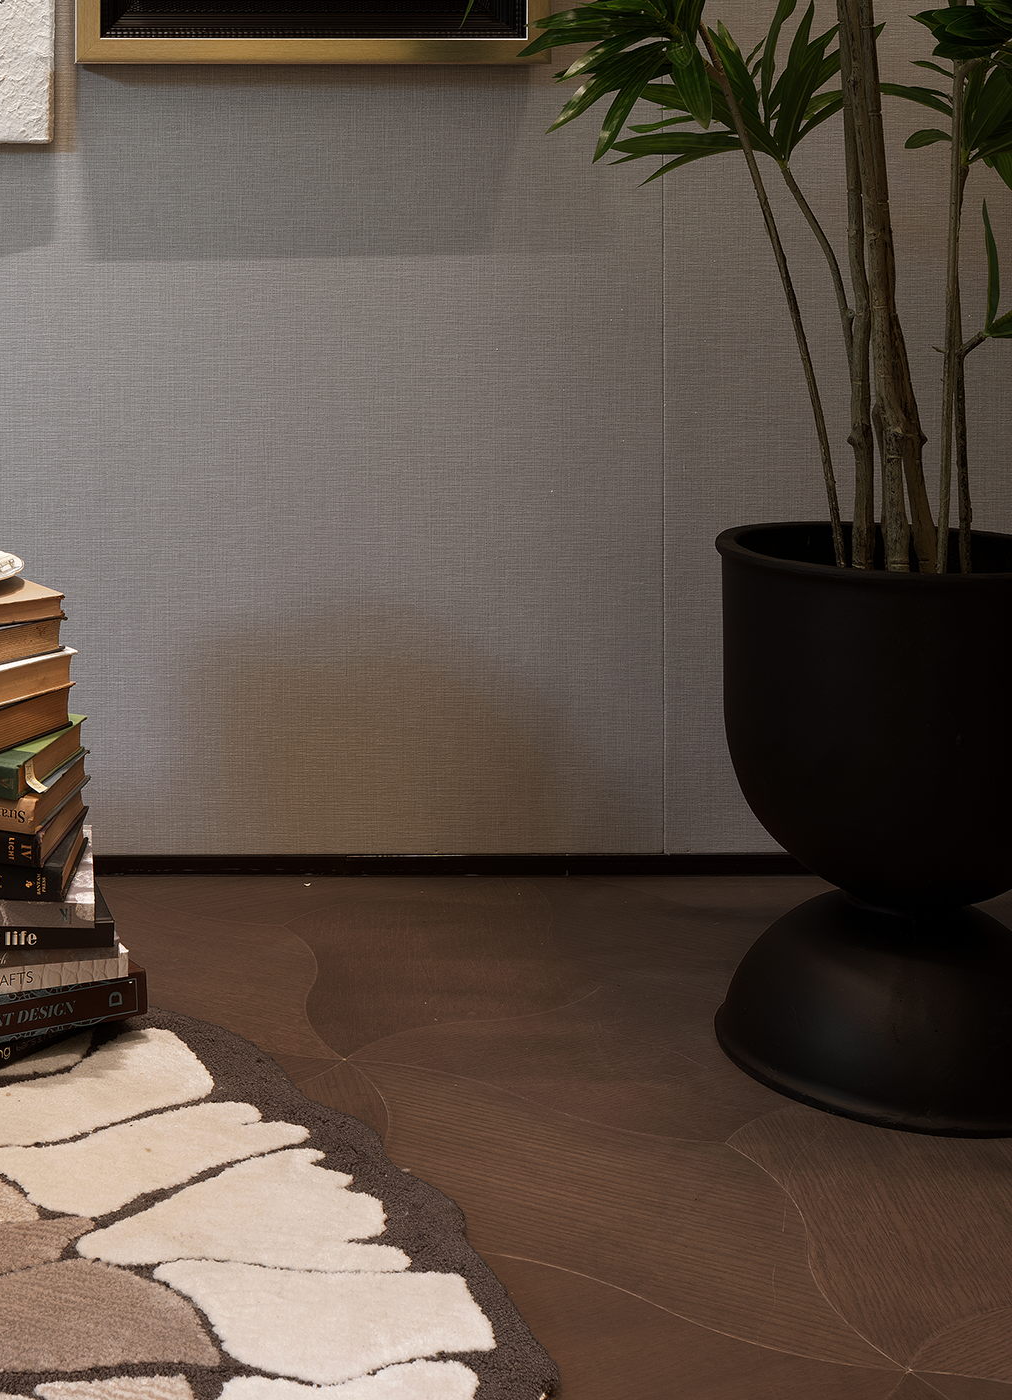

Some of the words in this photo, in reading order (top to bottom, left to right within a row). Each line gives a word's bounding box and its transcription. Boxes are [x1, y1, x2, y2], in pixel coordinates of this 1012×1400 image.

[20, 843, 32, 860] IV
[4, 930, 38, 946] life
[17, 1000, 76, 1025] DESIGN
